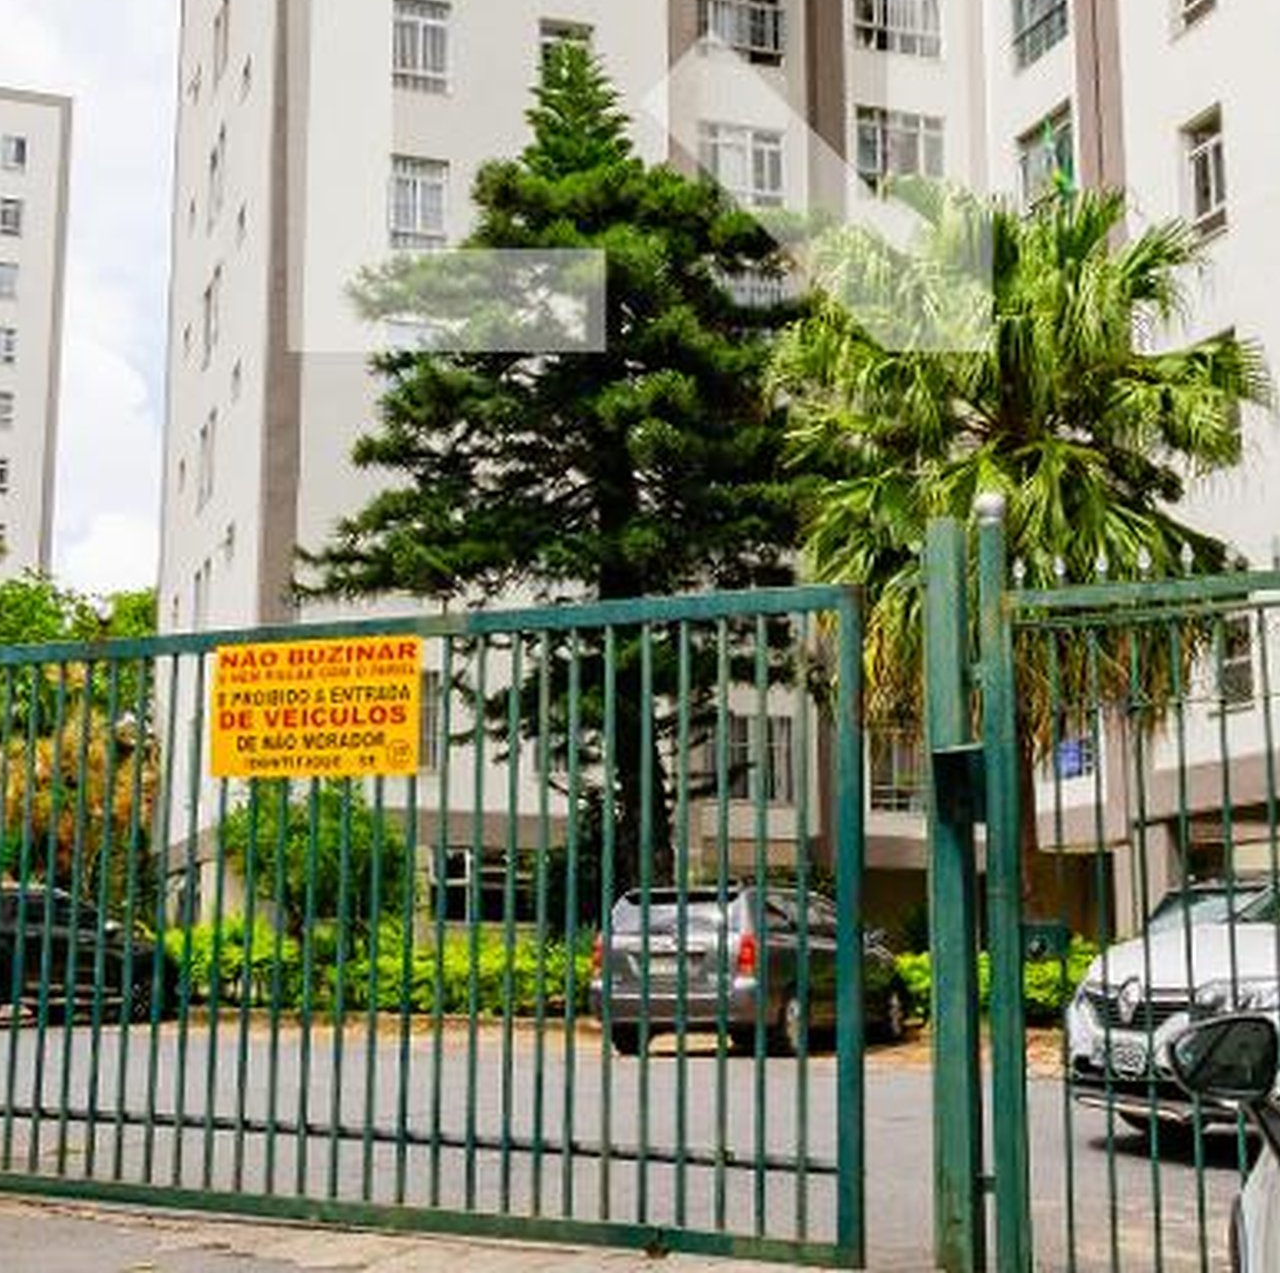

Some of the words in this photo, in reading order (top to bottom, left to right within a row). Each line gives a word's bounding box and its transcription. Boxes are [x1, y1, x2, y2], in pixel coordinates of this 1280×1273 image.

[289, 642, 417, 665] BUZINAR
[330, 684, 411, 704] ENTRADA
[220, 711, 254, 731] DE
[236, 734, 257, 752] DE
[303, 731, 385, 750] MORADOR
